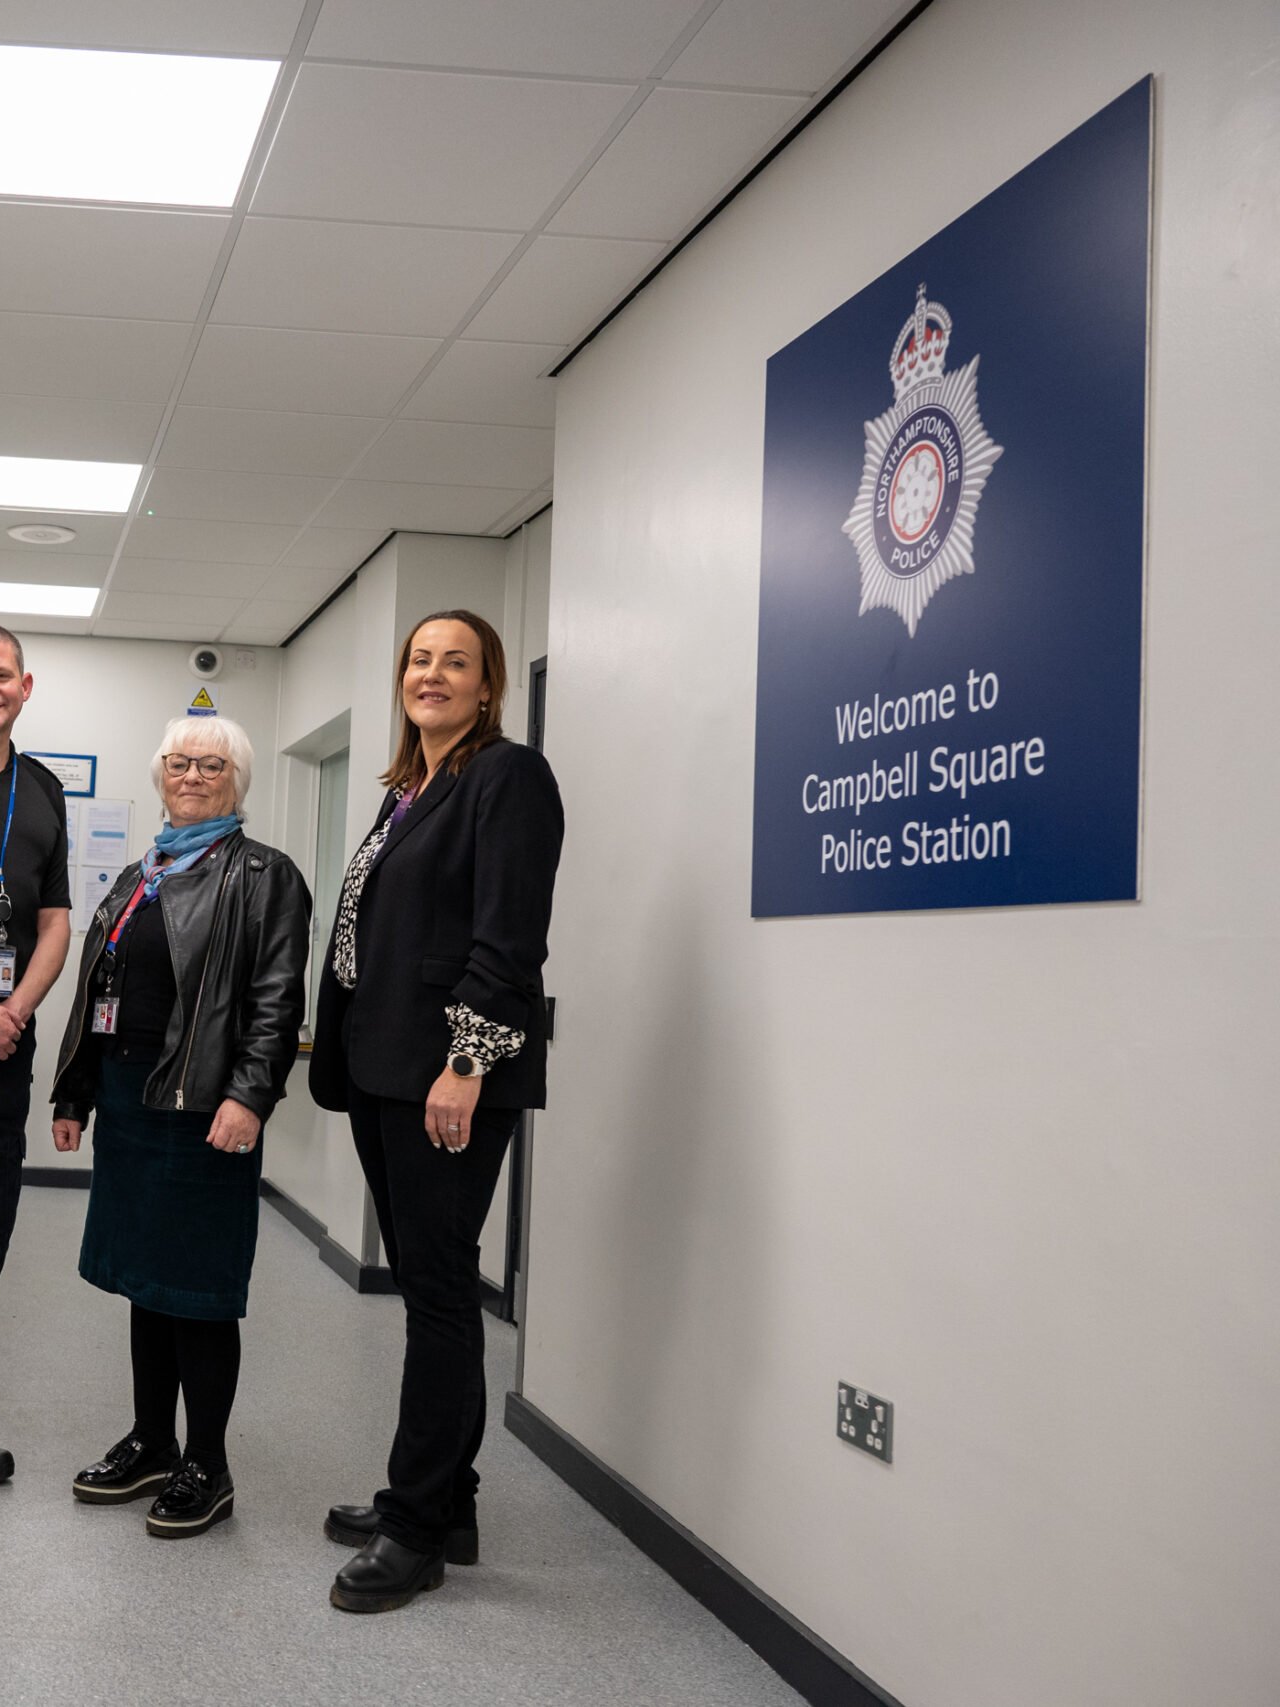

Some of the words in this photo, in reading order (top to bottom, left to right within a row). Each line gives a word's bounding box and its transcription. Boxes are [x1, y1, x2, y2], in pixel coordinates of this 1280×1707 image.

[876, 416, 959, 518] NORTHAMPTONSHIRE
[890, 529, 941, 569] POLICE
[835, 682, 956, 744] Welcome
[967, 668, 999, 713] to
[801, 748, 918, 815] Campbell
[929, 735, 1046, 798] Square
[821, 828, 891, 874] Police
[900, 814, 1011, 867] Station
